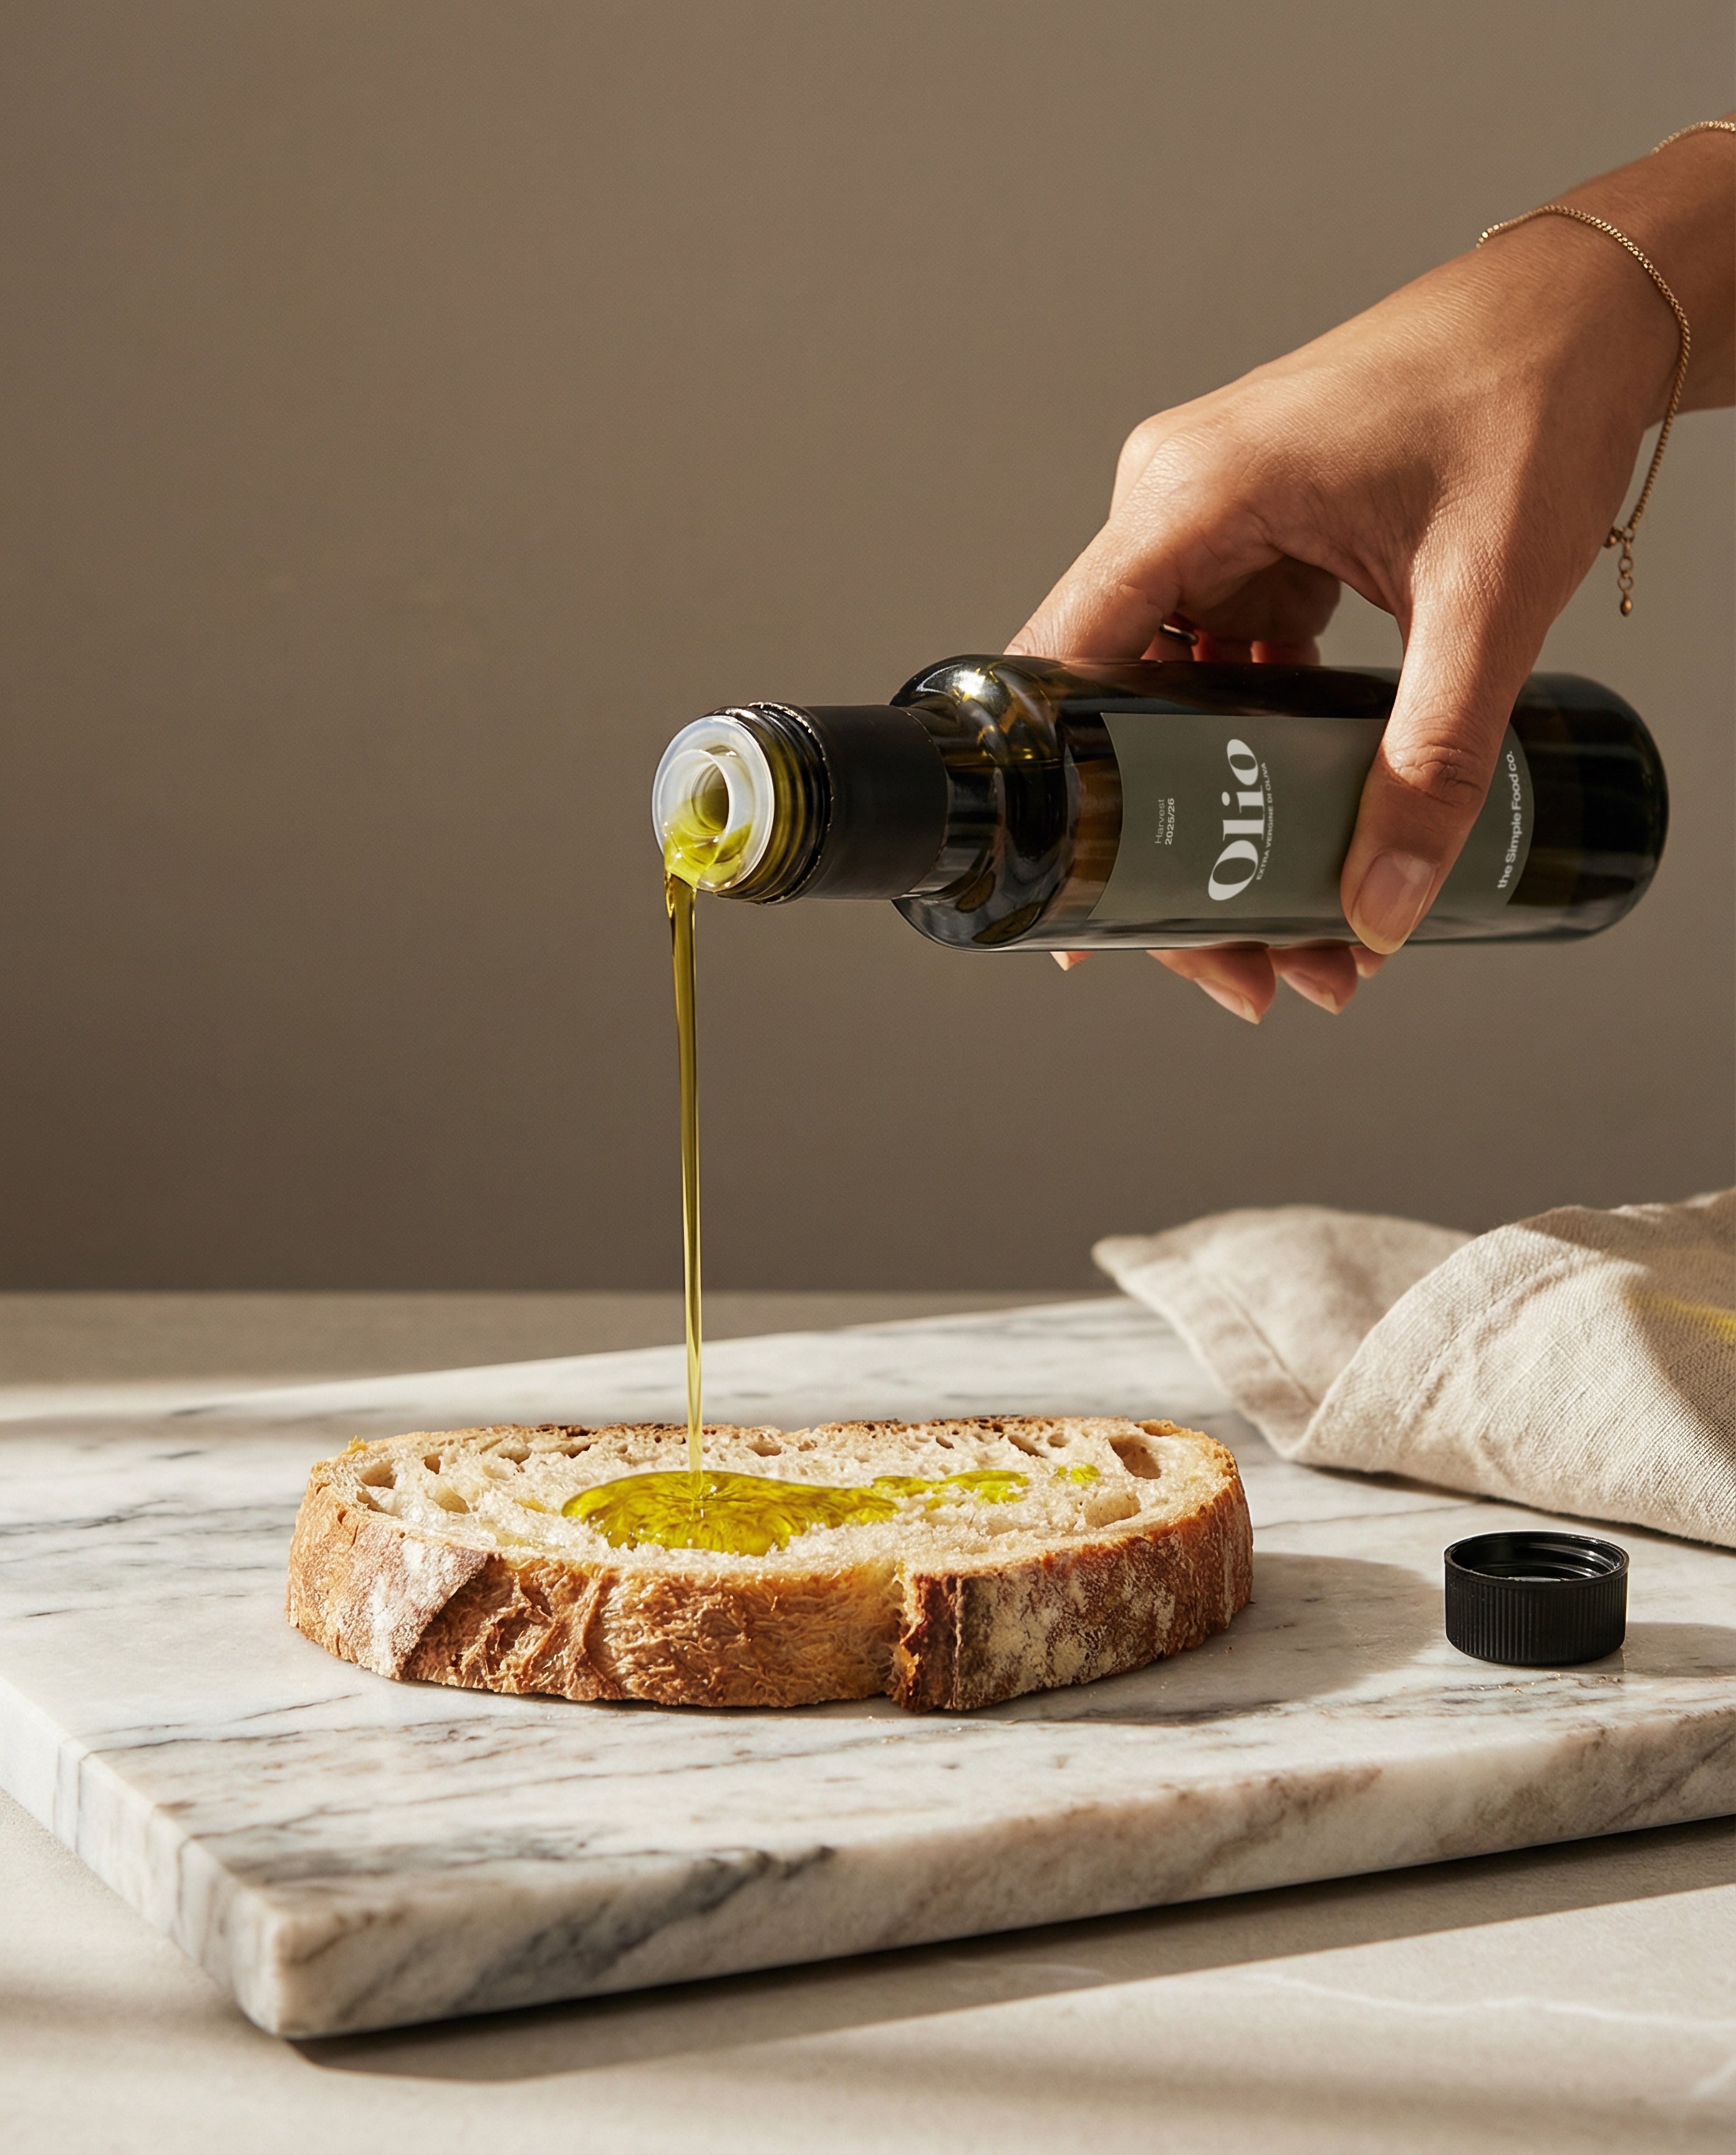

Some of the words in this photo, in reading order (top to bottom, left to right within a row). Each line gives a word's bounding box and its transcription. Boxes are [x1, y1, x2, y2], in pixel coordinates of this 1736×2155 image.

[1261, 763, 1271, 791] OLIVA
[1507, 751, 1517, 771] co.
[1267, 793, 1273, 803] DI
[1508, 774, 1521, 810] Food
[1154, 799, 1165, 844] Harvest
[1165, 798, 1175, 845] 2025/26
[1208, 739, 1265, 900] Olio
[1505, 812, 1523, 863] Simple
[1256, 850, 1270, 880] EXTRA
[1497, 865, 1513, 889] the
